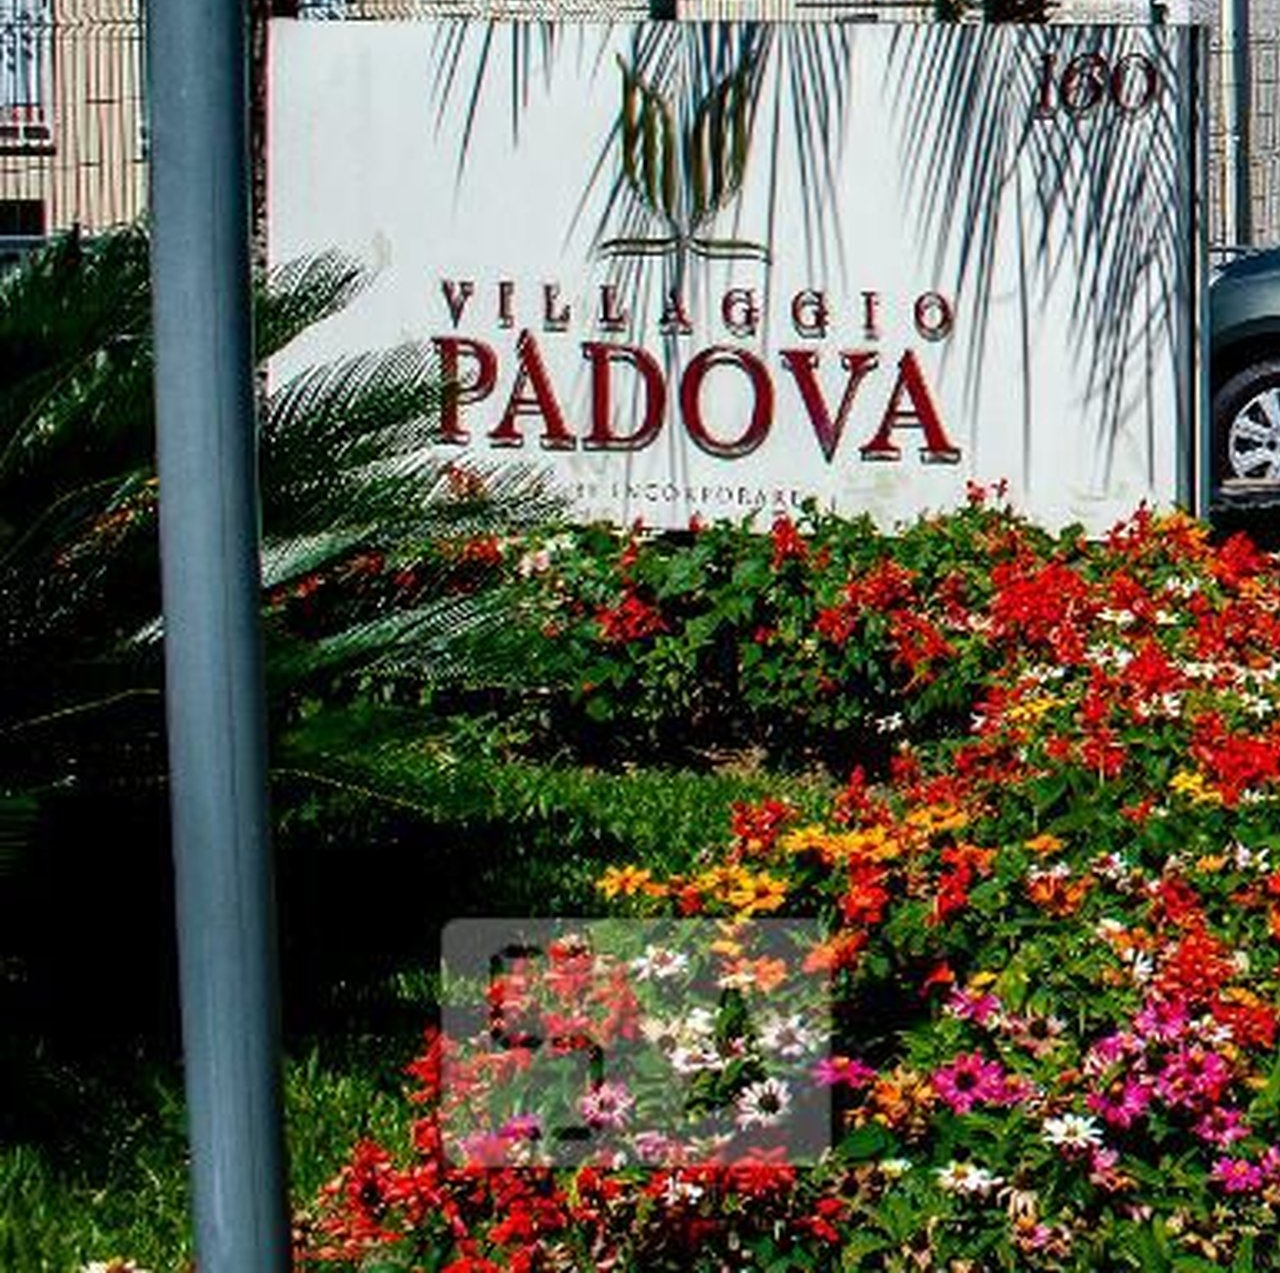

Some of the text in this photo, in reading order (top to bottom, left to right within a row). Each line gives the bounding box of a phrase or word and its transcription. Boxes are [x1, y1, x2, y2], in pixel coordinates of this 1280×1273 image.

[1034, 52, 1158, 119] 160
[441, 278, 956, 342] VILLAGGIO
[430, 328, 962, 464] PADOVA
